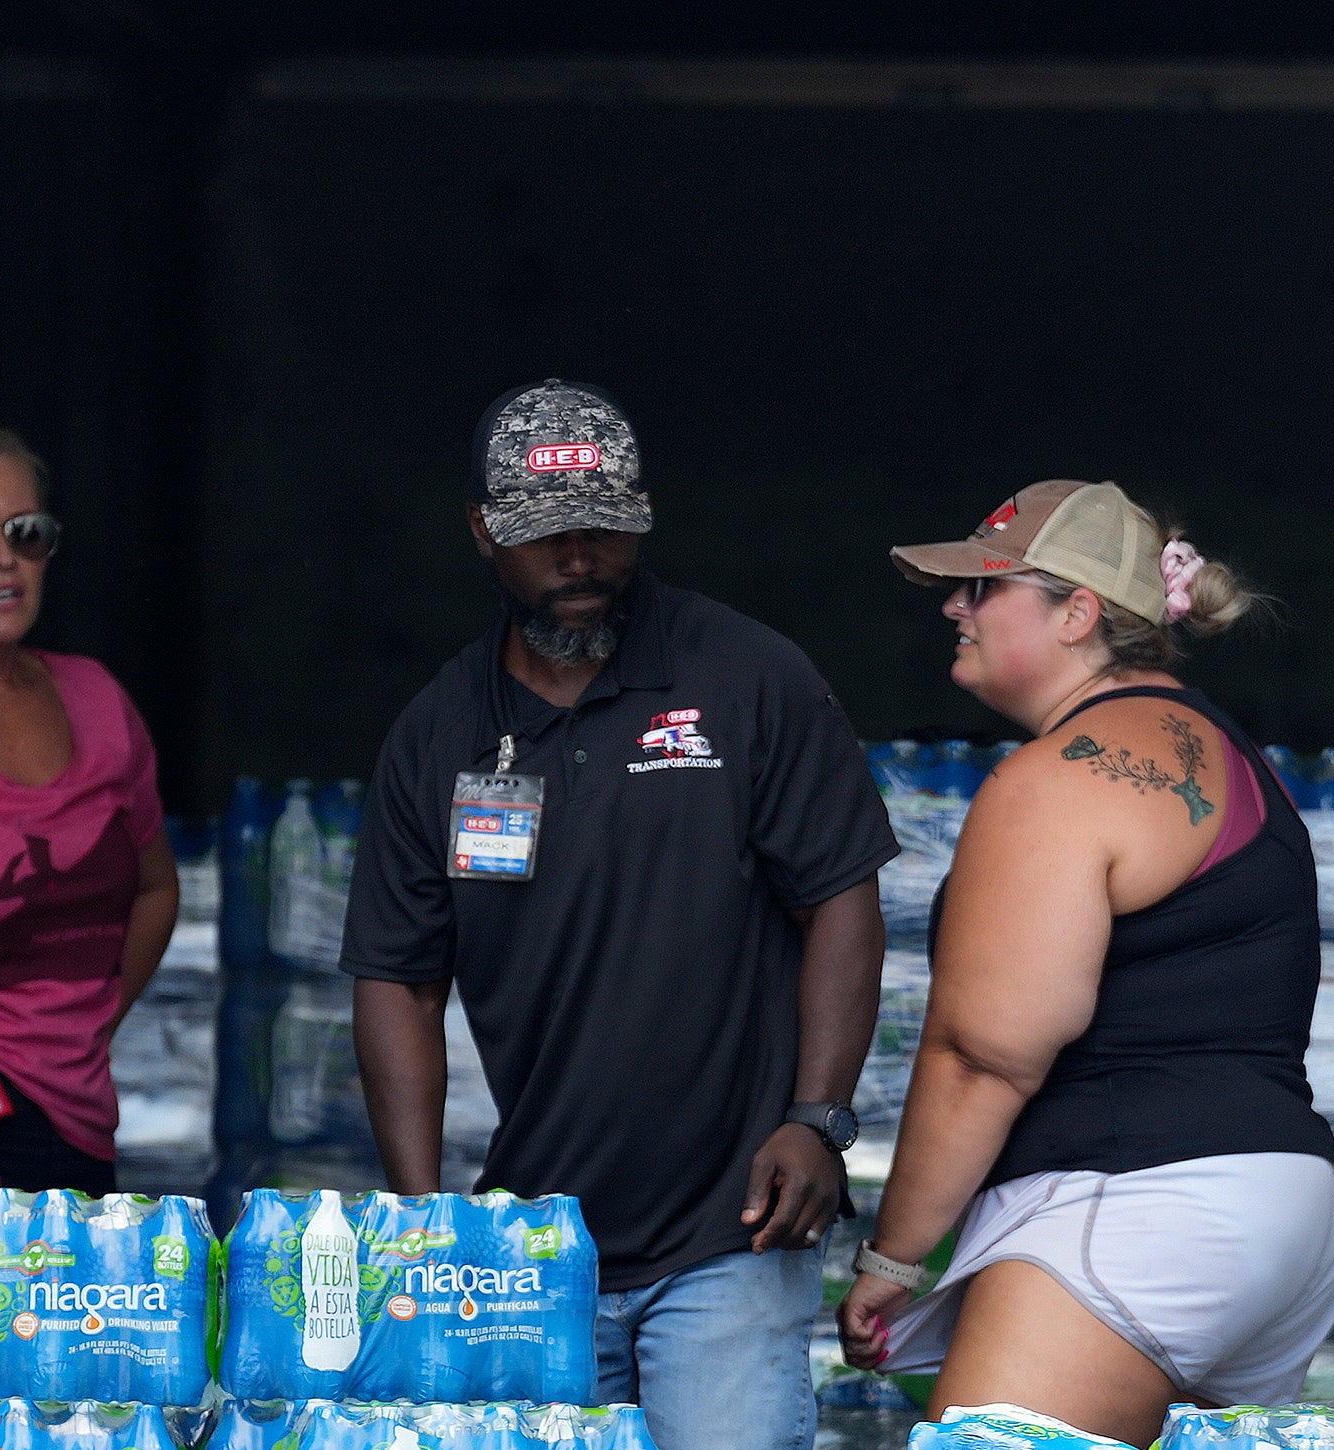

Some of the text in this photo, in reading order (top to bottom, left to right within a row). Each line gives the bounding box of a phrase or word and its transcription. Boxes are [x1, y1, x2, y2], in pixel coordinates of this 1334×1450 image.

[983, 557, 1011, 571] kw
[627, 758, 723, 773] TRANSPORTATION
[472, 840, 509, 850] MACK
[306, 1233, 332, 1252] DALE
[529, 1229, 555, 1249] 24
[158, 1245, 184, 1261] 24
[157, 1261, 184, 1270] BOTTLES
[307, 1254, 352, 1288] VIDA
[405, 1260, 541, 1321] niagara
[29, 1277, 168, 1335] niagara
[310, 1289, 351, 1315] A ÉSTA
[426, 1300, 539, 1313] AGUA PURIFICADA
[41, 1317, 178, 1332] PURIFIED DRINKING WATER
[309, 1316, 355, 1339] BOTELLA
